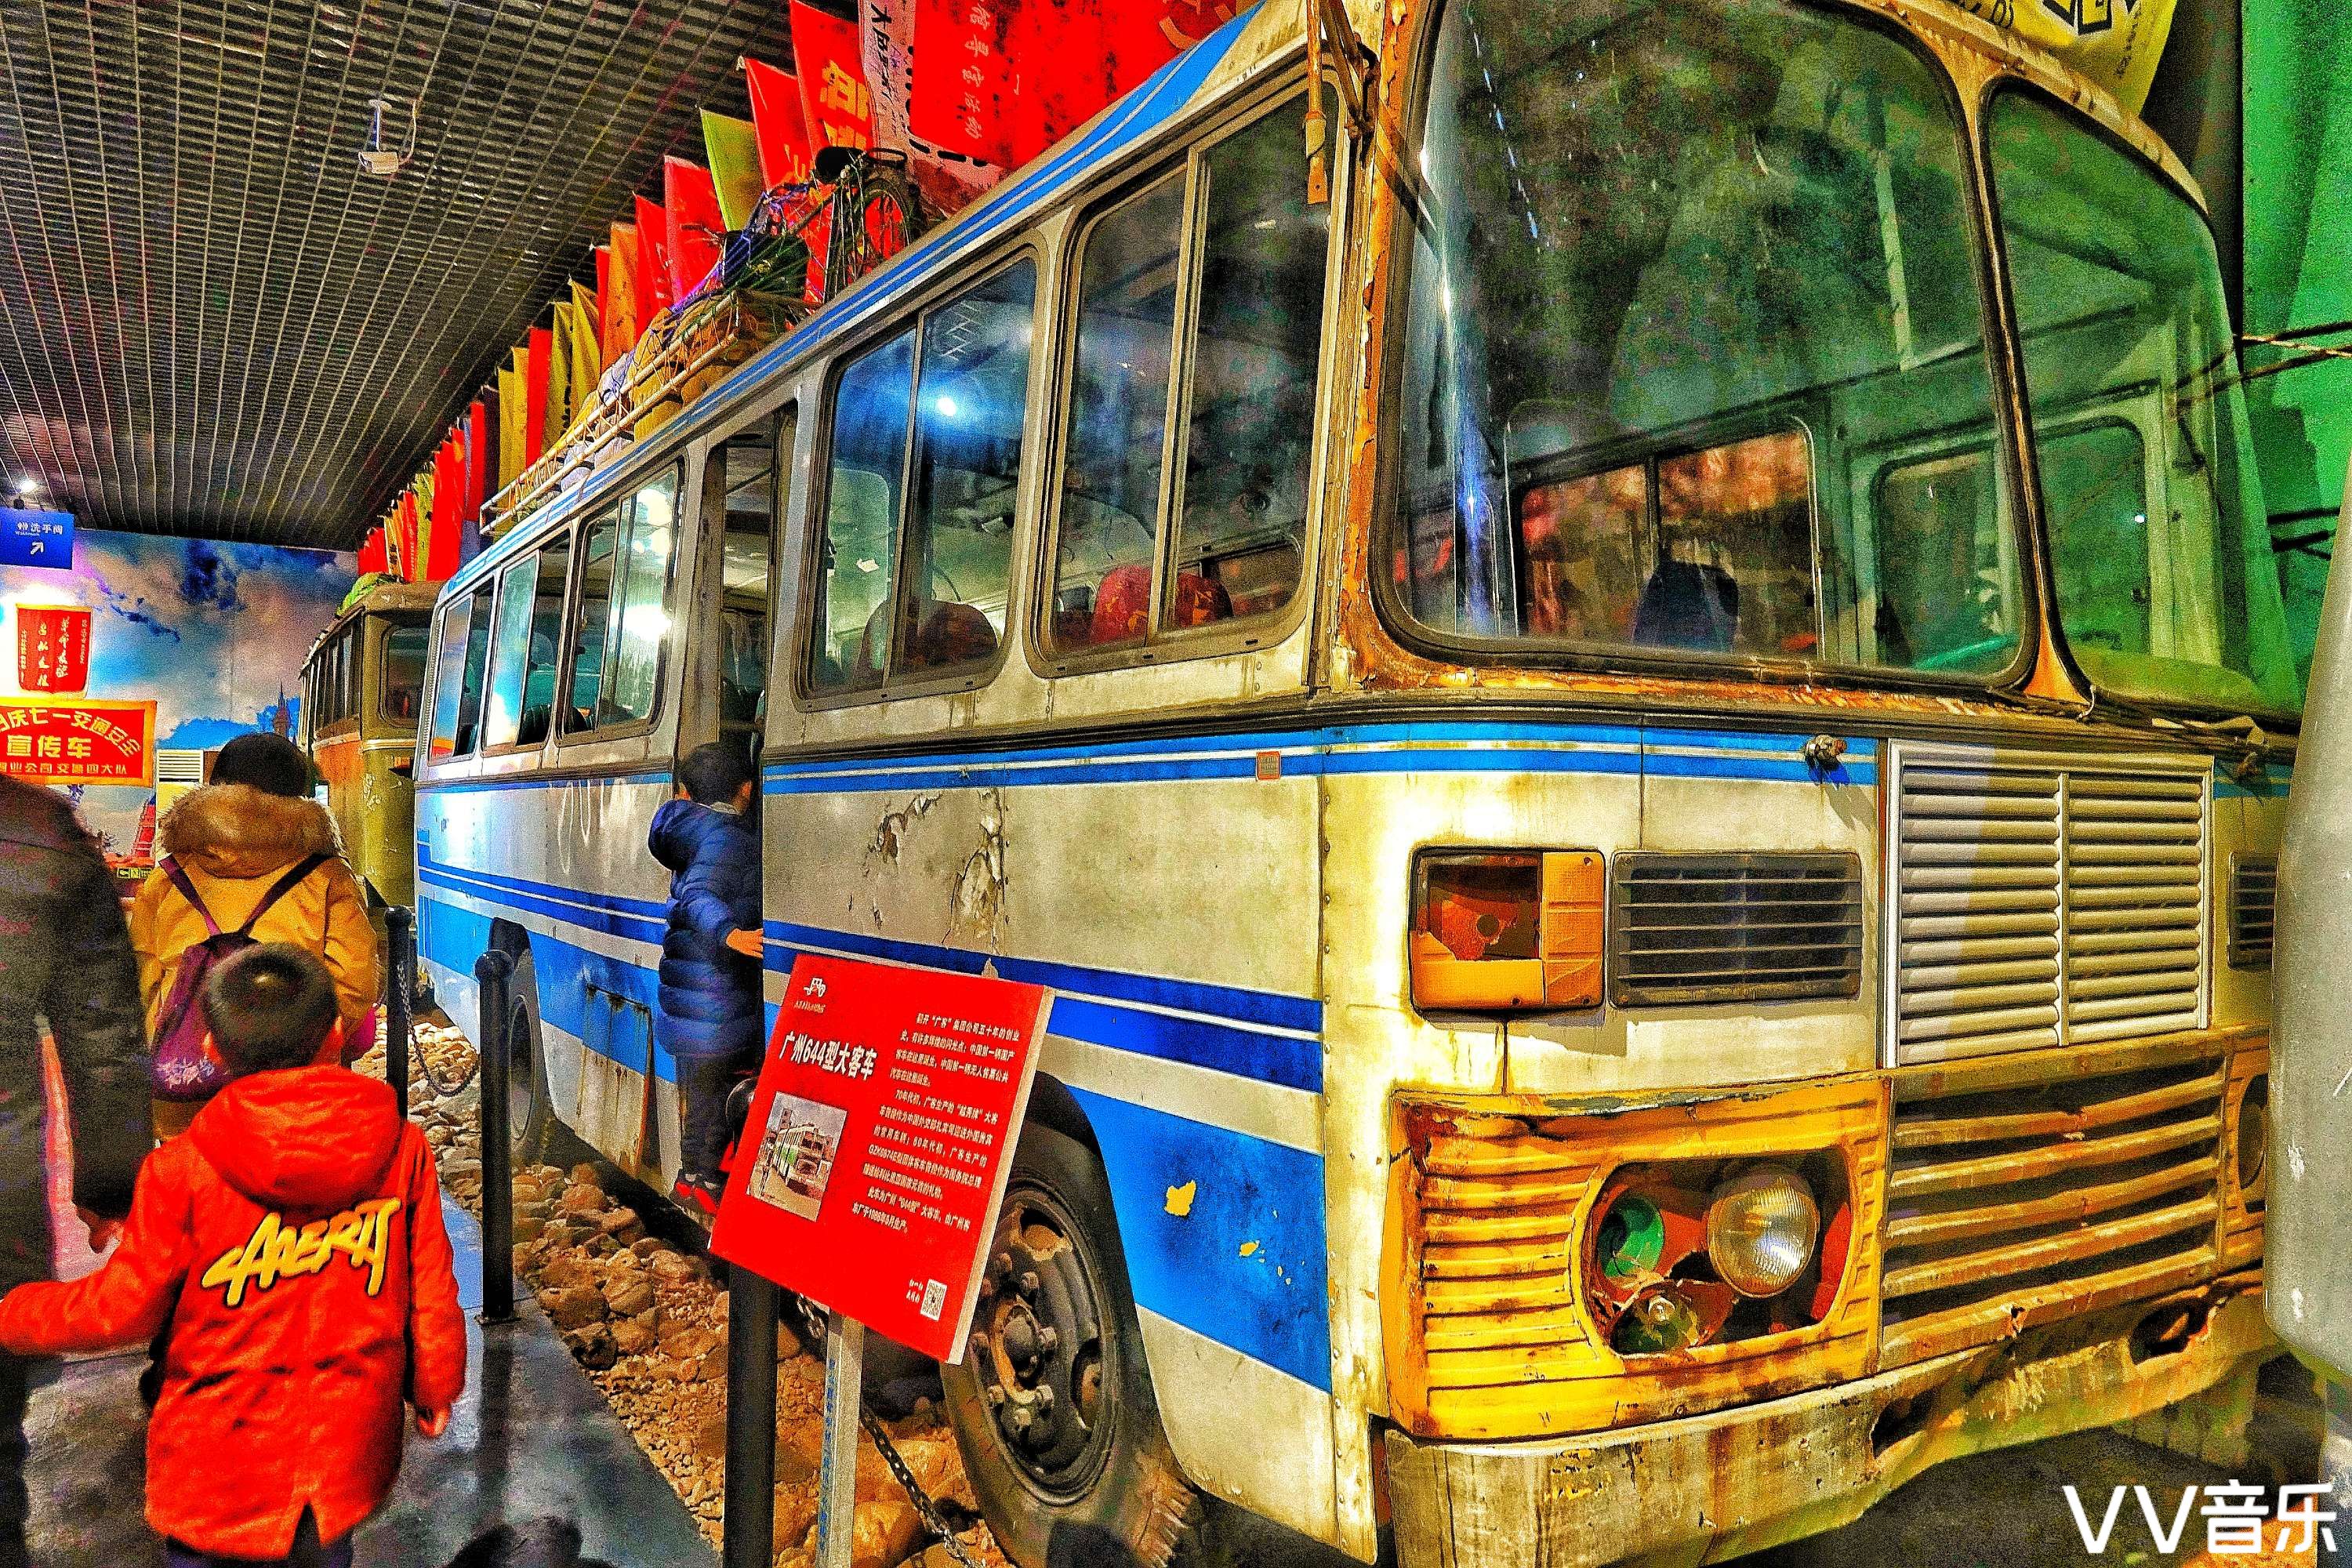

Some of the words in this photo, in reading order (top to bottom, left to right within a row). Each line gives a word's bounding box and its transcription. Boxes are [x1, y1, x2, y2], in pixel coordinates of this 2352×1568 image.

[6, 735, 93, 759] 宣传车
[779, 1030, 878, 1081] 广州644型大客车
